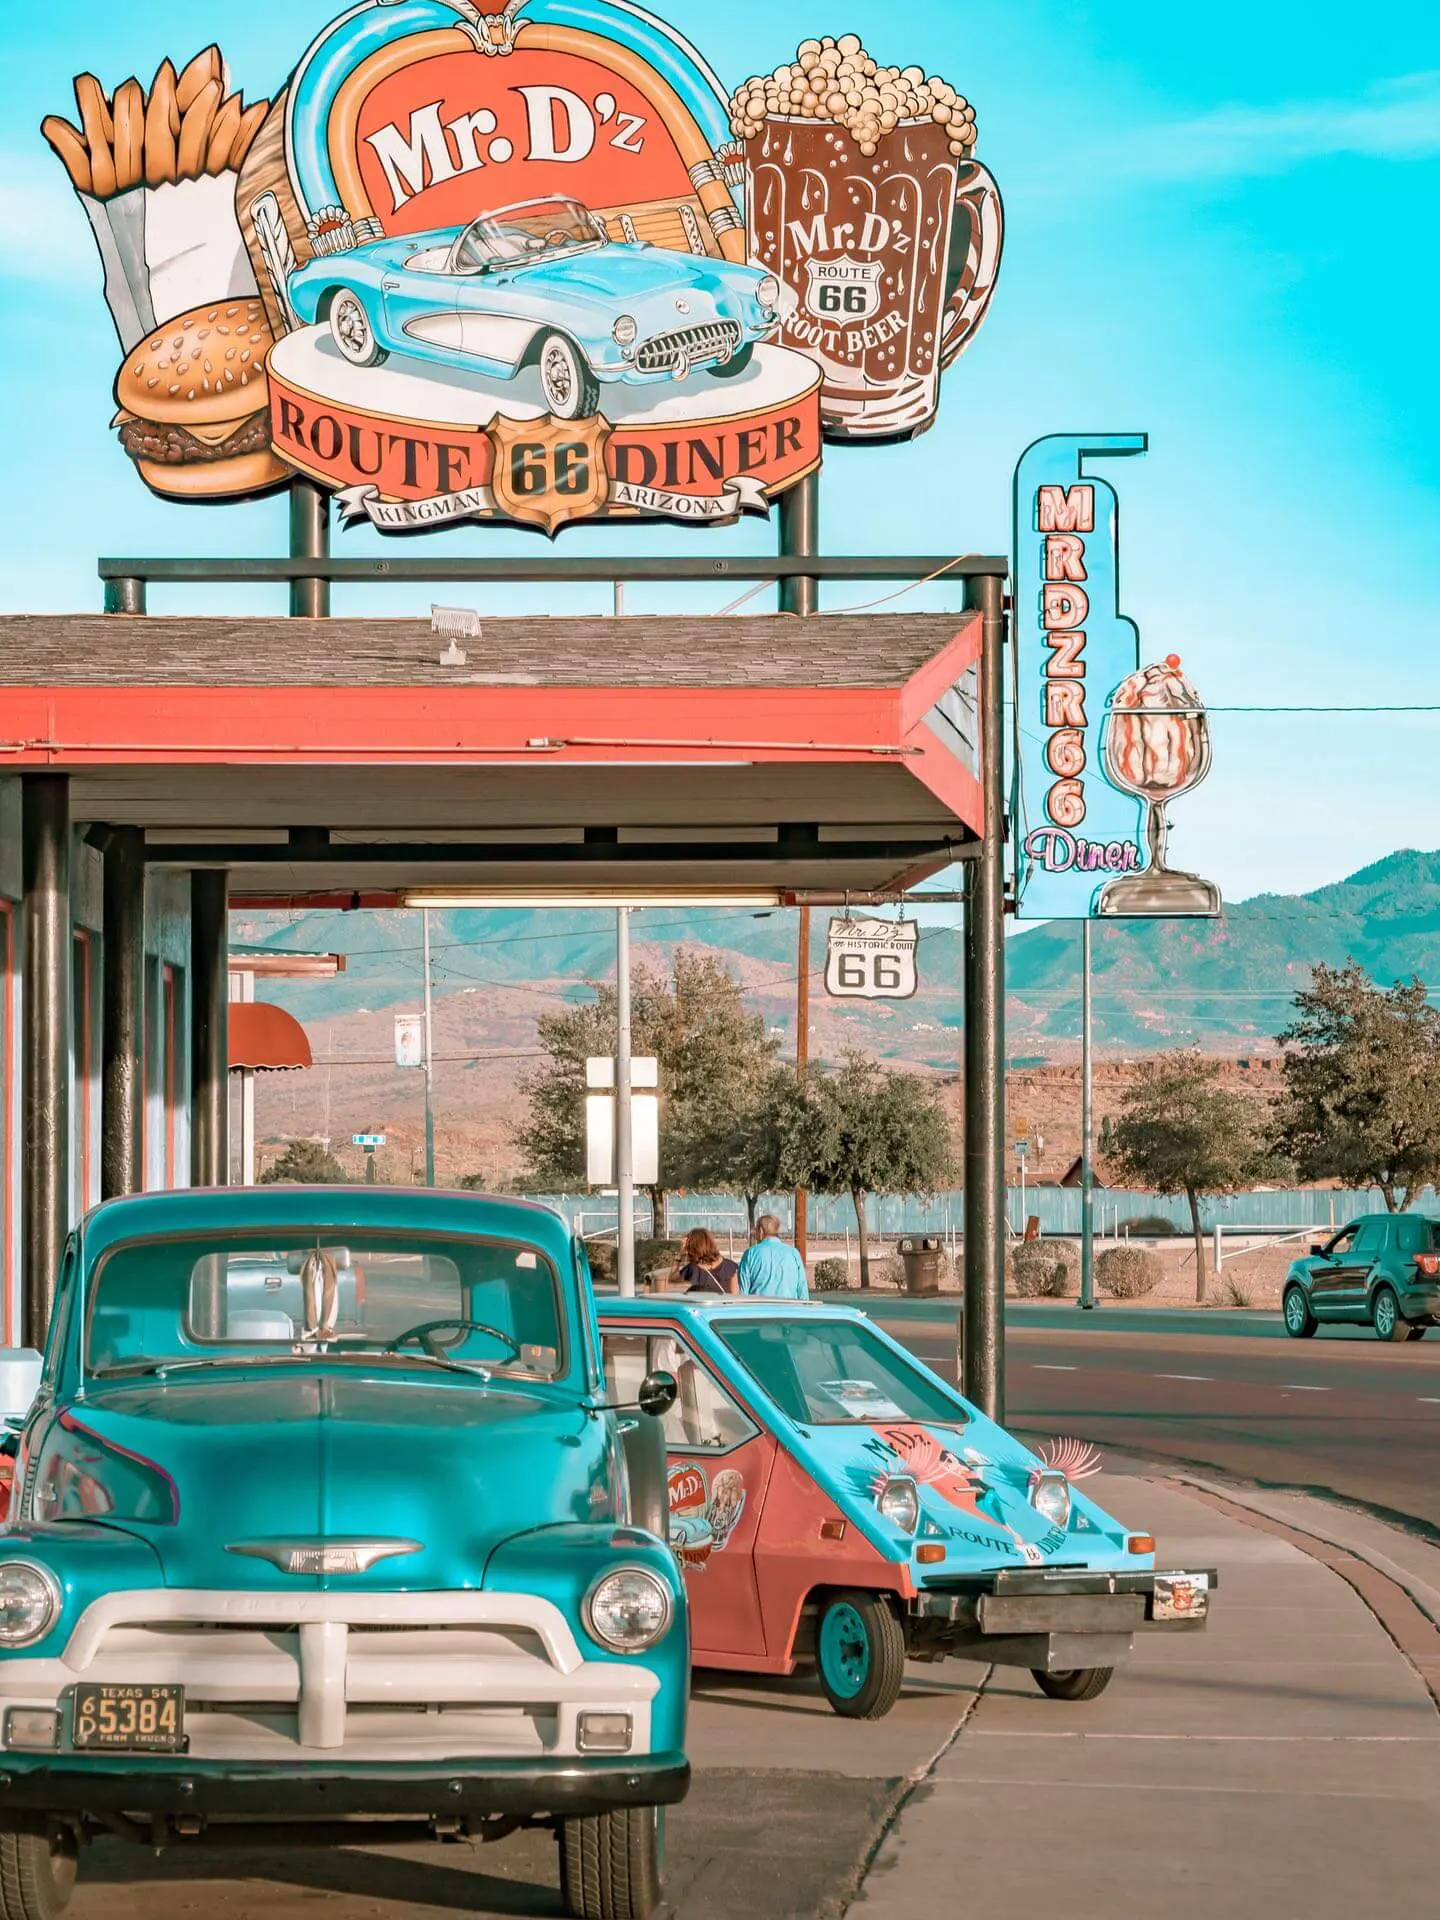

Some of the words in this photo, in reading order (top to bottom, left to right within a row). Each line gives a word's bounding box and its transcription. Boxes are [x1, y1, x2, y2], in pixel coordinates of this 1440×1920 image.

[363, 99, 514, 216] Mr.
[507, 84, 648, 164] D'z
[785, 212, 856, 260] Mr.
[858, 211, 912, 255] D'z
[817, 266, 872, 280] ROUTE
[819, 285, 867, 313] 66
[785, 312, 841, 352] ROOT
[846, 310, 909, 353] BEER
[278, 396, 473, 493] ROUTE
[511, 442, 590, 496] 66
[613, 416, 805, 488] DINER
[377, 491, 481, 523] KINGMAN
[616, 486, 726, 514] ARIZONA
[1024, 826, 1142, 873] Diner
[847, 941, 889, 949] HISTORIC
[838, 953, 901, 989] 66
[948, 1526, 1019, 1556] ROUTE
[101, 1688, 143, 1698] TEXAS
[151, 1688, 169, 1698] 54
[99, 1699, 177, 1734] 5384
